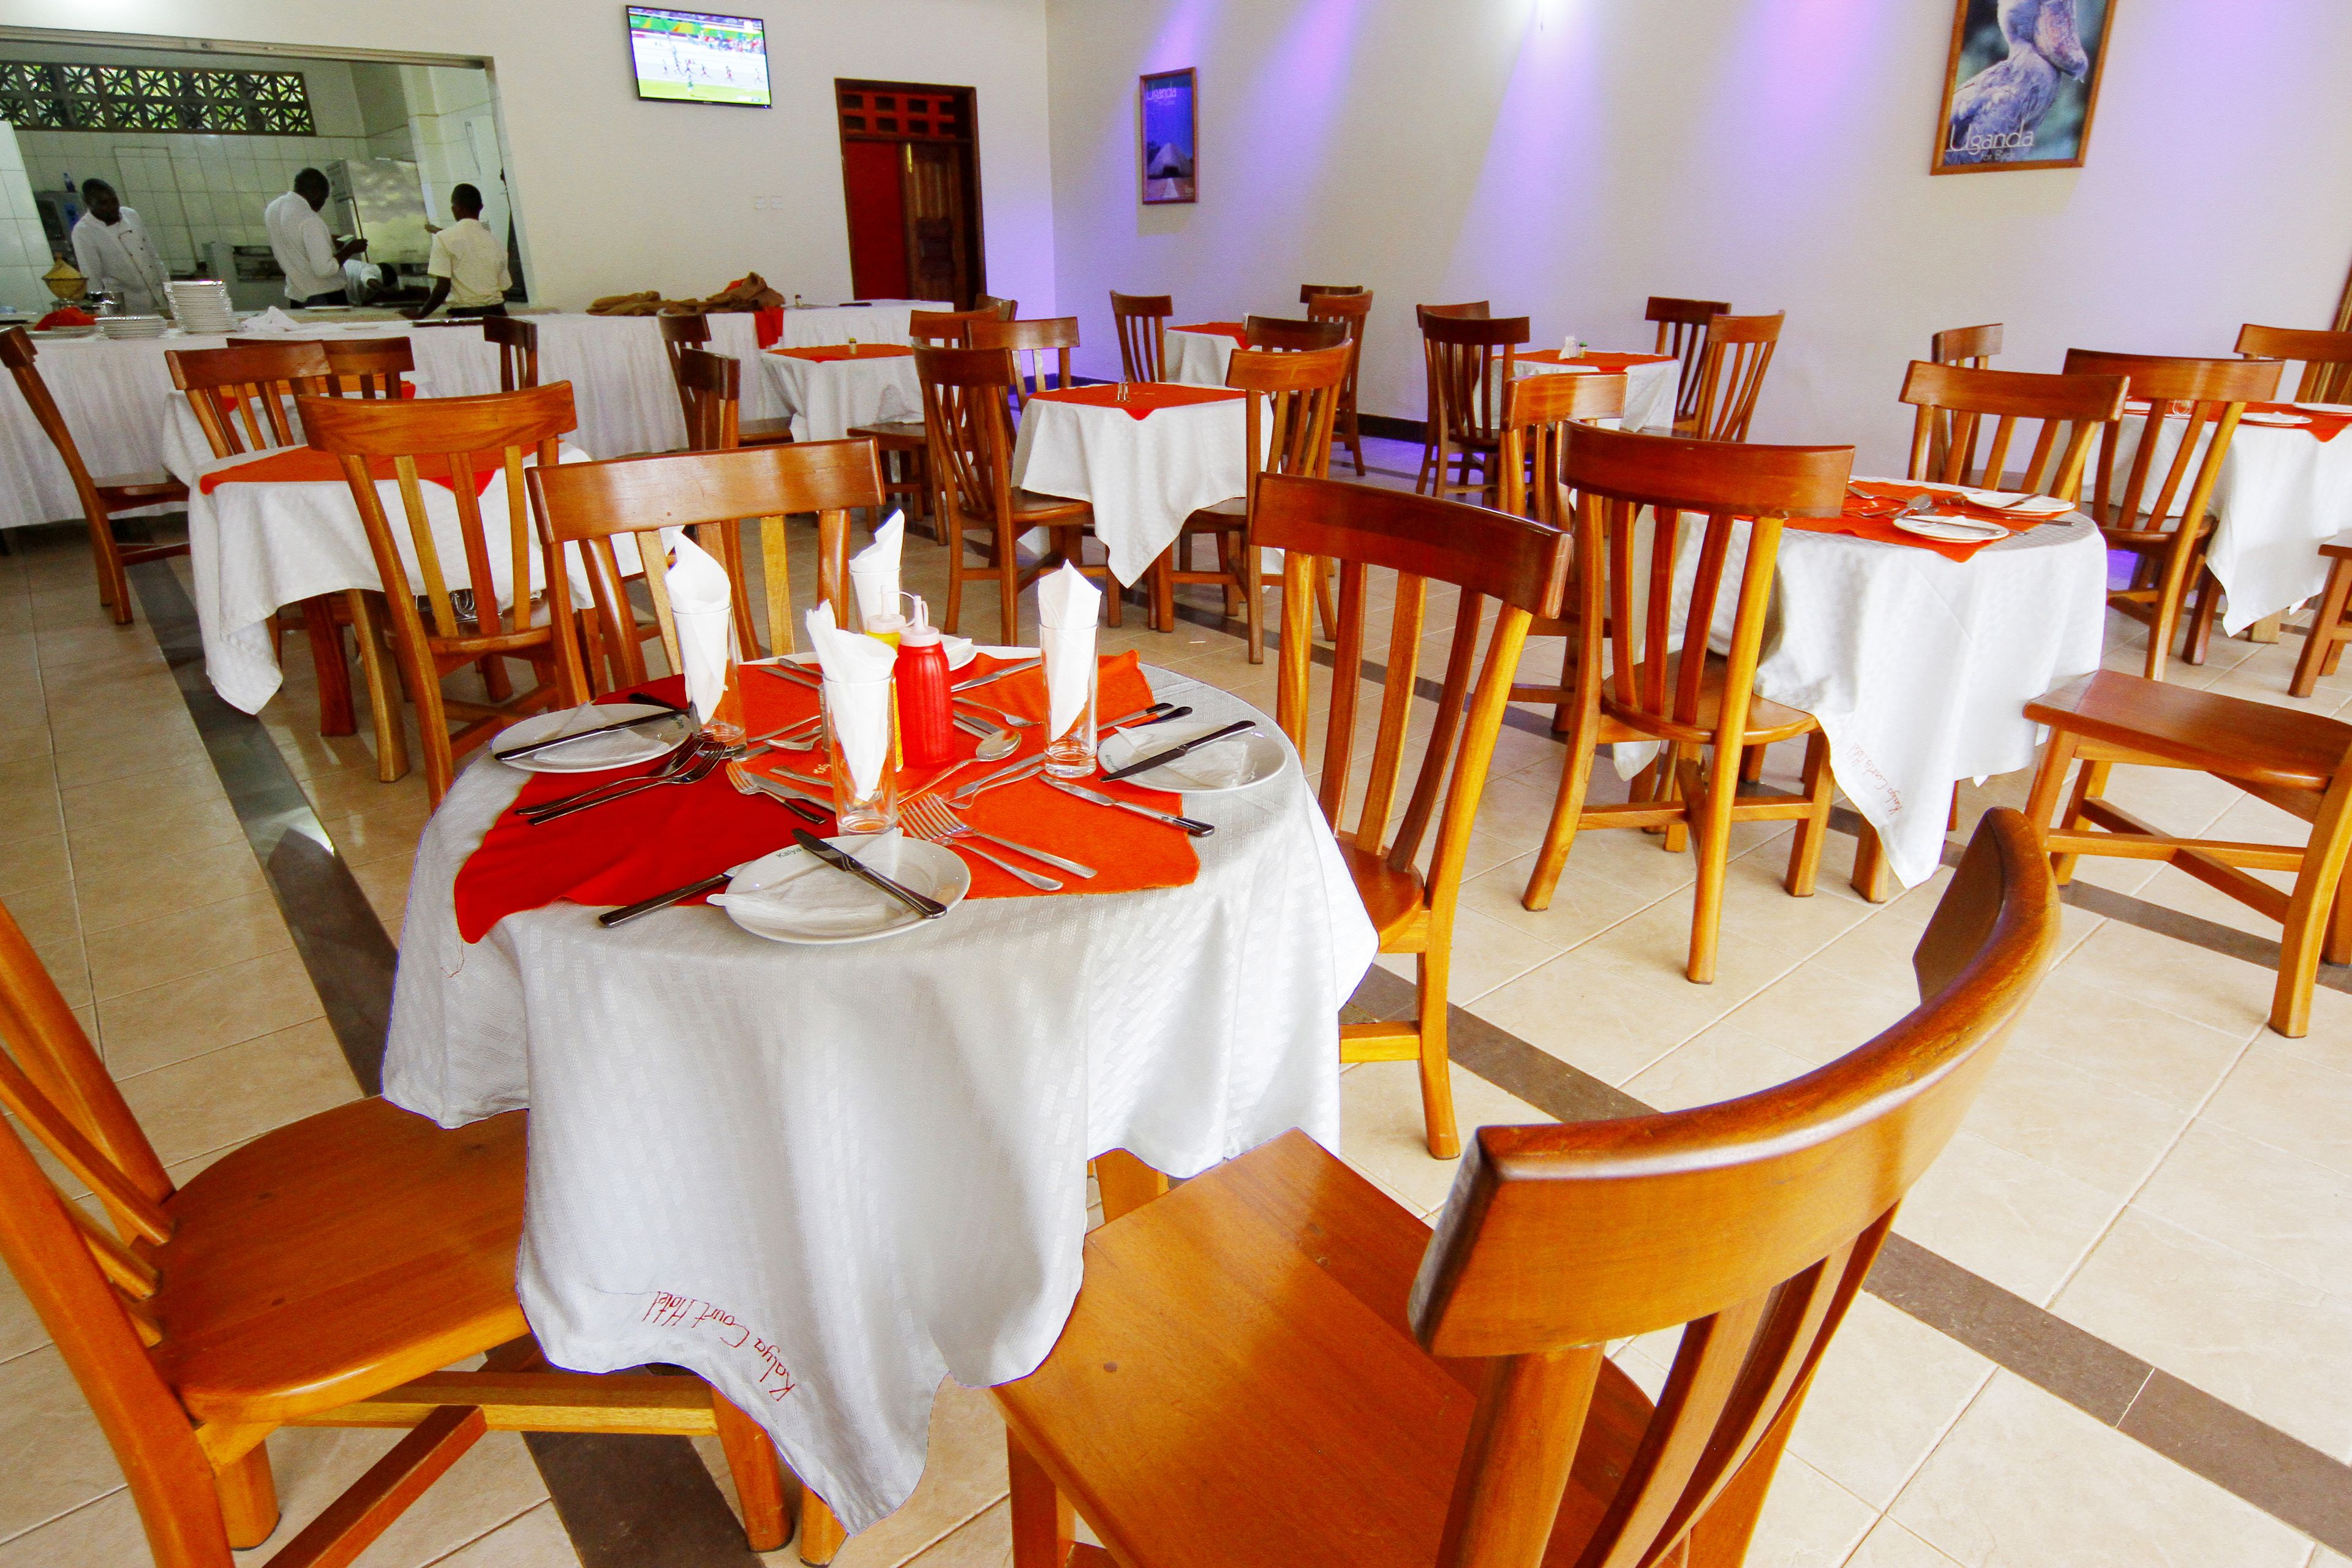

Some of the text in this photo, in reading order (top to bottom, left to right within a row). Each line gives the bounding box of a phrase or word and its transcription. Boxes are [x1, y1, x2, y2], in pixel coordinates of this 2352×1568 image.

[1950, 119, 2035, 155] Uganda
[776, 847, 802, 858] Kalya
[641, 1291, 796, 1402] Kalya Court Hotel
